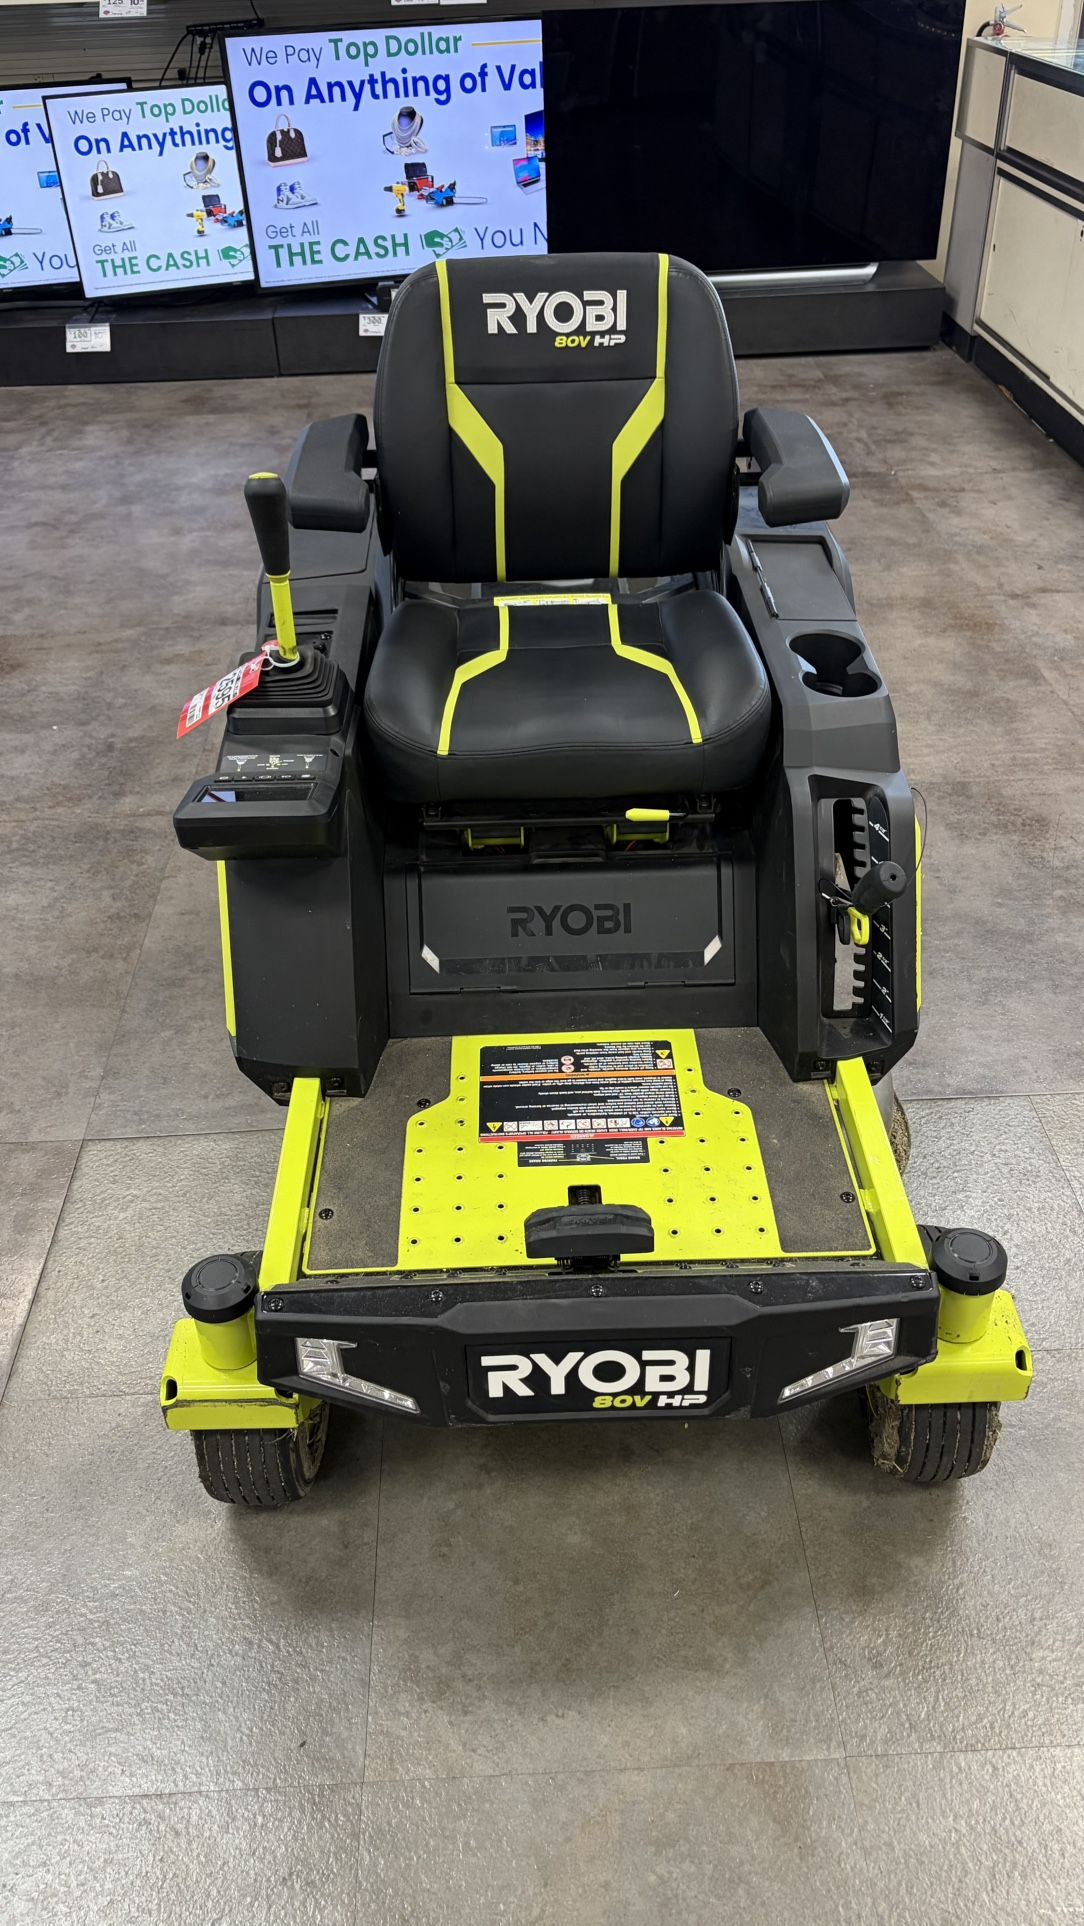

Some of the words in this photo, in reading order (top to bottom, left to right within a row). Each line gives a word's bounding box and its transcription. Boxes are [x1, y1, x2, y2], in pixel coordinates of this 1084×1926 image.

[242, 46, 278, 67] We
[284, 44, 323, 69] Pay
[328, 37, 379, 68] Top
[384, 31, 462, 58] Dollar
[247, 79, 295, 108] On
[304, 67, 452, 112] Anything
[459, 62, 489, 94] of
[67, 108, 96, 125] We
[101, 107, 132, 126] Pay
[136, 101, 177, 123] Top
[5, 121, 31, 147] of
[73, 134, 111, 156] On
[118, 121, 235, 157] Anything
[265, 222, 297, 240] Get
[301, 219, 320, 237] All
[92, 243, 118, 257] Get
[121, 239, 137, 254] All
[95, 256, 141, 278] THE
[145, 248, 210, 273] CASH
[268, 240, 323, 269] THE
[330, 232, 410, 263] CASH
[474, 226, 524, 251] You
[482, 289, 628, 334] RYOBI
[554, 335, 591, 348] 80V
[593, 334, 626, 347] HP
[506, 902, 632, 938] RYOBI
[481, 1348, 711, 1398] RYOBI
[592, 1395, 652, 1409] 80V
[657, 1394, 708, 1407] HP
